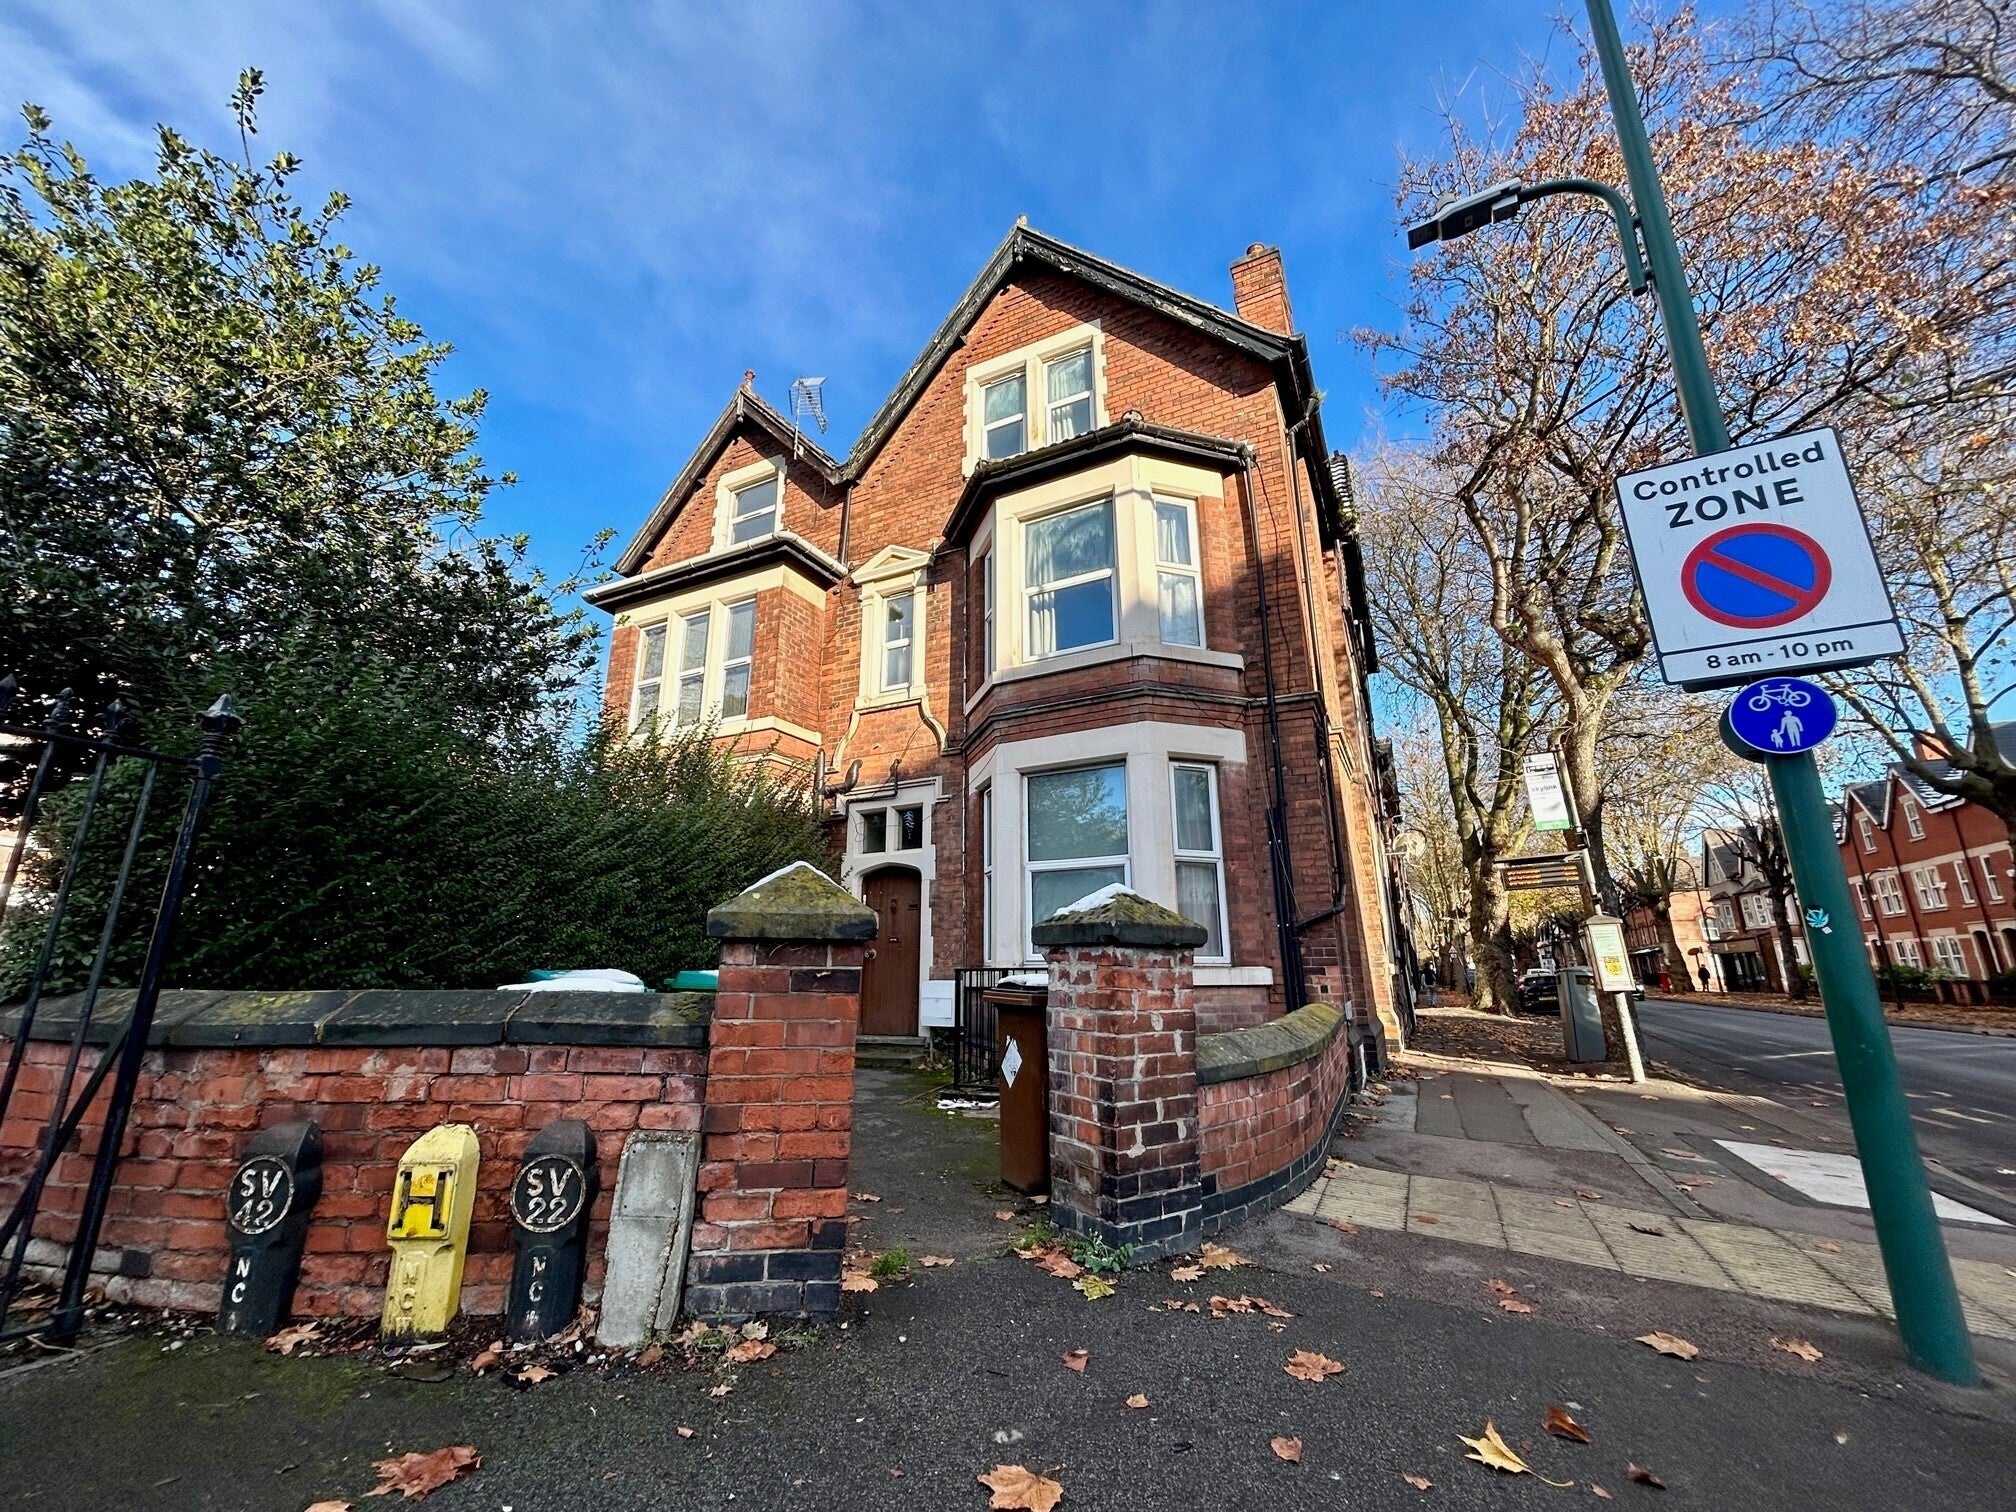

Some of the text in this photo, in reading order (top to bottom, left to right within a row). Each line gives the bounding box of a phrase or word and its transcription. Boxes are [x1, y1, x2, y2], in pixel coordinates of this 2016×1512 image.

[1633, 441, 1825, 500] Controlled
[1665, 478, 1804, 529] ZONE
[1706, 655, 1721, 669] 8
[1727, 652, 1761, 666] am
[1780, 642, 1809, 659] 10
[1815, 639, 1854, 657] pm
[240, 1169, 284, 1198] SV
[527, 1168, 573, 1197] SV
[233, 1199, 274, 1227] 42
[394, 1171, 449, 1230] H
[526, 1196, 567, 1225] 22
